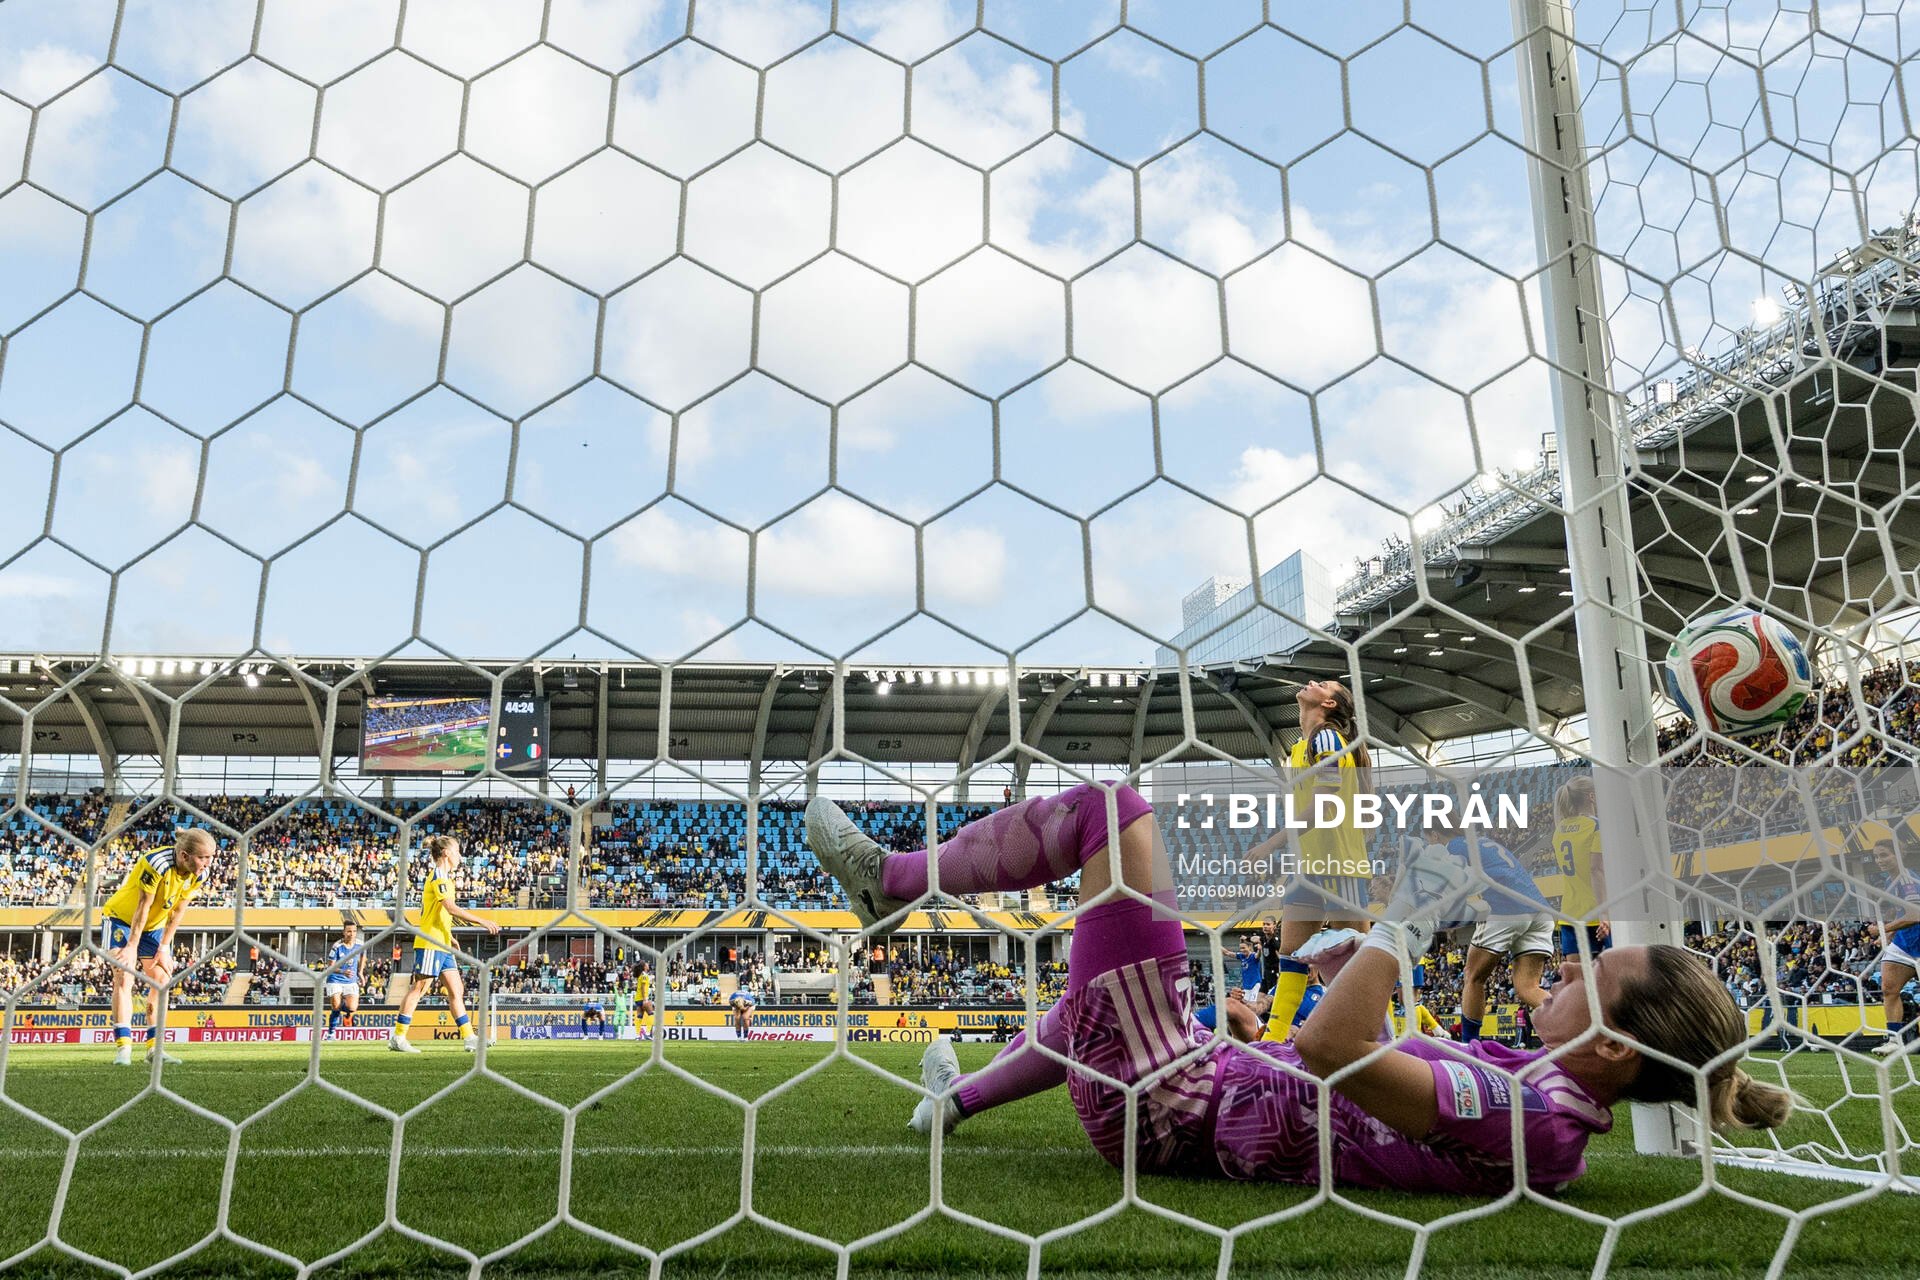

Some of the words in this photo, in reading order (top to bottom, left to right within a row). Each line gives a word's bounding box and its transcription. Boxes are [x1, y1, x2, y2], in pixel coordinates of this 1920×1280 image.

[504, 702, 534, 714] 44:24
[34, 731, 62, 741] P2
[532, 727, 538, 737] 1
[232, 733, 259, 743] P3
[878, 740, 902, 749] B3
[1066, 741, 1092, 751] B2
[1560, 840, 1576, 877] 3
[4, 1014, 83, 1026] LLAMMANS
[86, 1013, 107, 1026] FÖR
[803, 1013, 824, 1026] FÖR
[826, 1014, 869, 1026] SVRIGE
[95, 1031, 174, 1043] BAHAS
[203, 1030, 282, 1041] BAUHAUS
[311, 1030, 388, 1041] AUHAUS
[748, 1030, 814, 1041] Interbus
